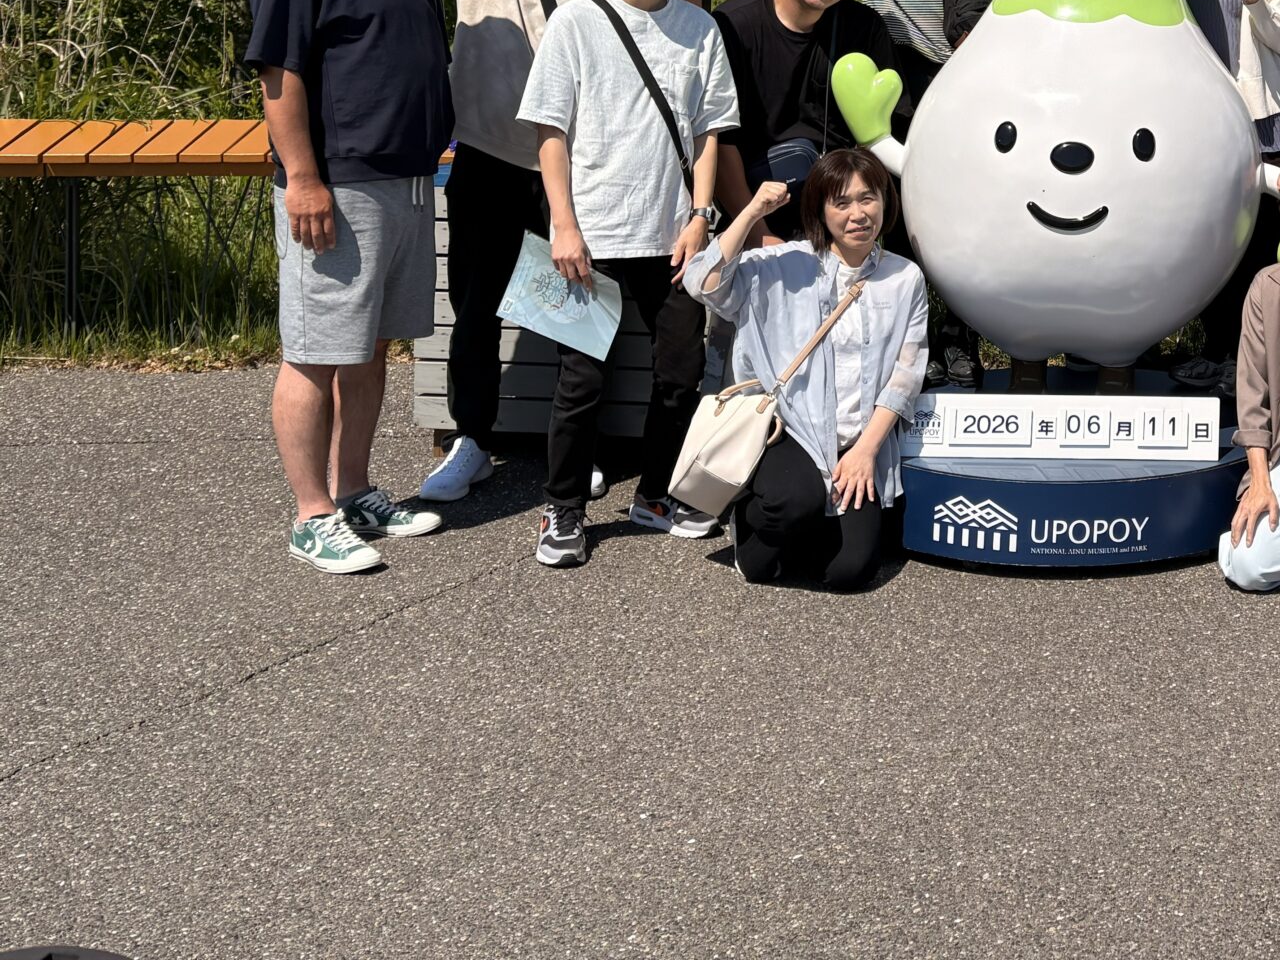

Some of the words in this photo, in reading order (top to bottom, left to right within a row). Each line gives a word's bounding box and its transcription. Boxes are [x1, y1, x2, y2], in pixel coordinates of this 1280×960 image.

[909, 428, 940, 436] UPOPOY
[963, 414, 1019, 434] 2026
[1038, 420, 1054, 436] 年
[1067, 414, 1101, 434] 06
[1116, 421, 1132, 437] 月
[1148, 416, 1176, 436] 11
[1195, 423, 1209, 439] 日
[1030, 516, 1149, 544] UPOPOY
[1030, 547, 1066, 555] NATIONAL
